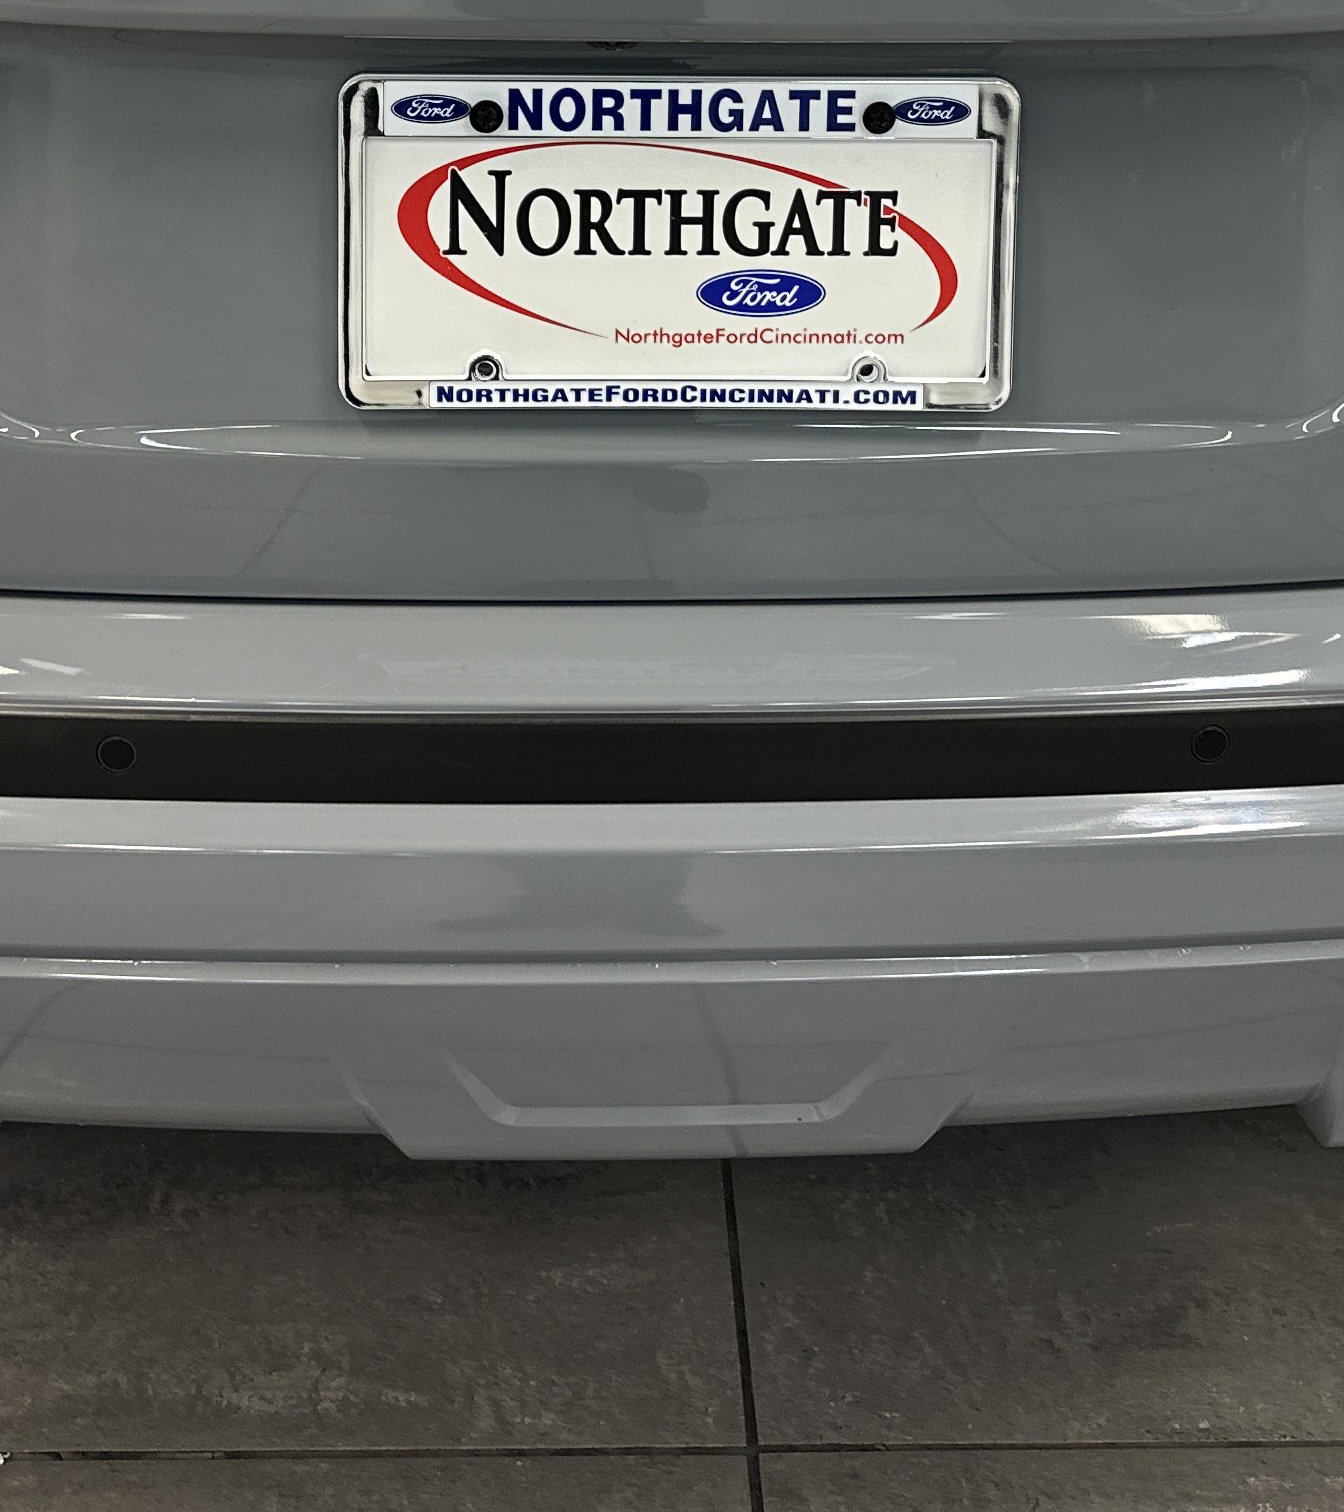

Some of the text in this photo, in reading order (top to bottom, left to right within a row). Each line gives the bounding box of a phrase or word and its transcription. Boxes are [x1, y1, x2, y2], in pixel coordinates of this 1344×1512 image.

[406, 98, 455, 118] Ford
[507, 87, 856, 133] NORTHGATE
[907, 100, 955, 121] Ford
[721, 276, 799, 308] Ford
[614, 327, 905, 348] NorthgateFordCincinnati.com
